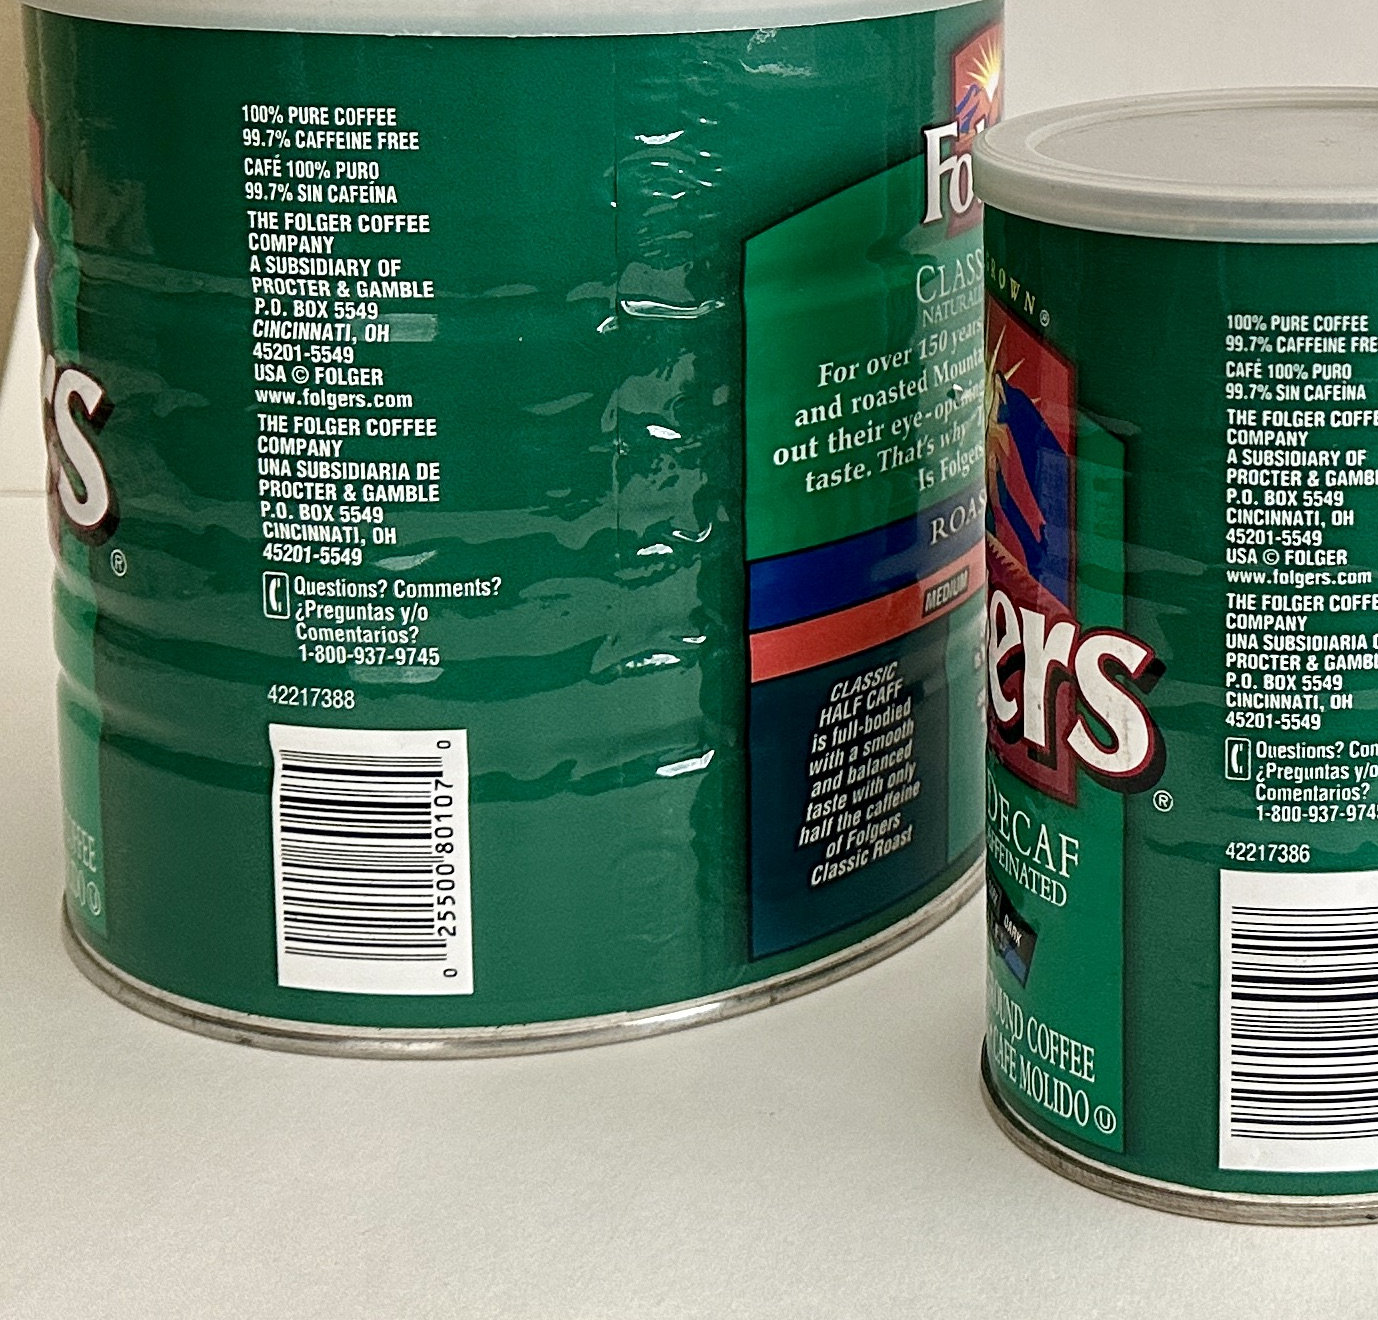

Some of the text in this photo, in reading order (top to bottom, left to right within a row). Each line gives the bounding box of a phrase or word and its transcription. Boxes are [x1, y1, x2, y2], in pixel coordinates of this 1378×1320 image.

[242, 106, 396, 126] 100% PURE COFFEE
[242, 129, 420, 150] 99.7% CAFFEINE FREE
[244, 154, 379, 180] CAFÉ 100% PURO
[245, 180, 397, 204] 99.7% SIN CAFEÍNA
[252, 277, 434, 298] PROCTER & GAMBLE
[255, 298, 378, 319] P.O. BOX 5549
[1227, 314, 1368, 332] 100% PURE COFFEE
[253, 342, 354, 363] 45201-5549
[1225, 335, 1272, 352] 99.7%
[1276, 336, 1346, 353] CAFFEINE
[254, 364, 286, 382] USA
[315, 368, 383, 385] FOLGER
[817, 347, 912, 387] For over
[255, 388, 412, 410] www.folgers.com
[1227, 429, 1308, 447] COMPANY
[805, 436, 935, 493] taste. That's
[294, 576, 502, 599] Questions? Comments?
[925, 571, 969, 608] MEDIUM
[295, 600, 429, 625] ¿Preguntas y/o
[296, 622, 419, 644] Comentarios?
[1226, 634, 1258, 650] UNA
[1263, 634, 1368, 652] SUBSIDIARIA
[298, 644, 440, 666] 1-800-937-9745
[830, 661, 898, 702] CLASSIC
[267, 684, 355, 709] 42217388
[819, 679, 903, 728] HALF CAFF
[1256, 741, 1344, 759] Questions?
[434, 740, 457, 977] 0 25500 80107 0
[1226, 842, 1310, 862] 42217386
[1027, 1016, 1095, 1084] COFFEE
[1019, 1058, 1090, 1127] MOLIDO
